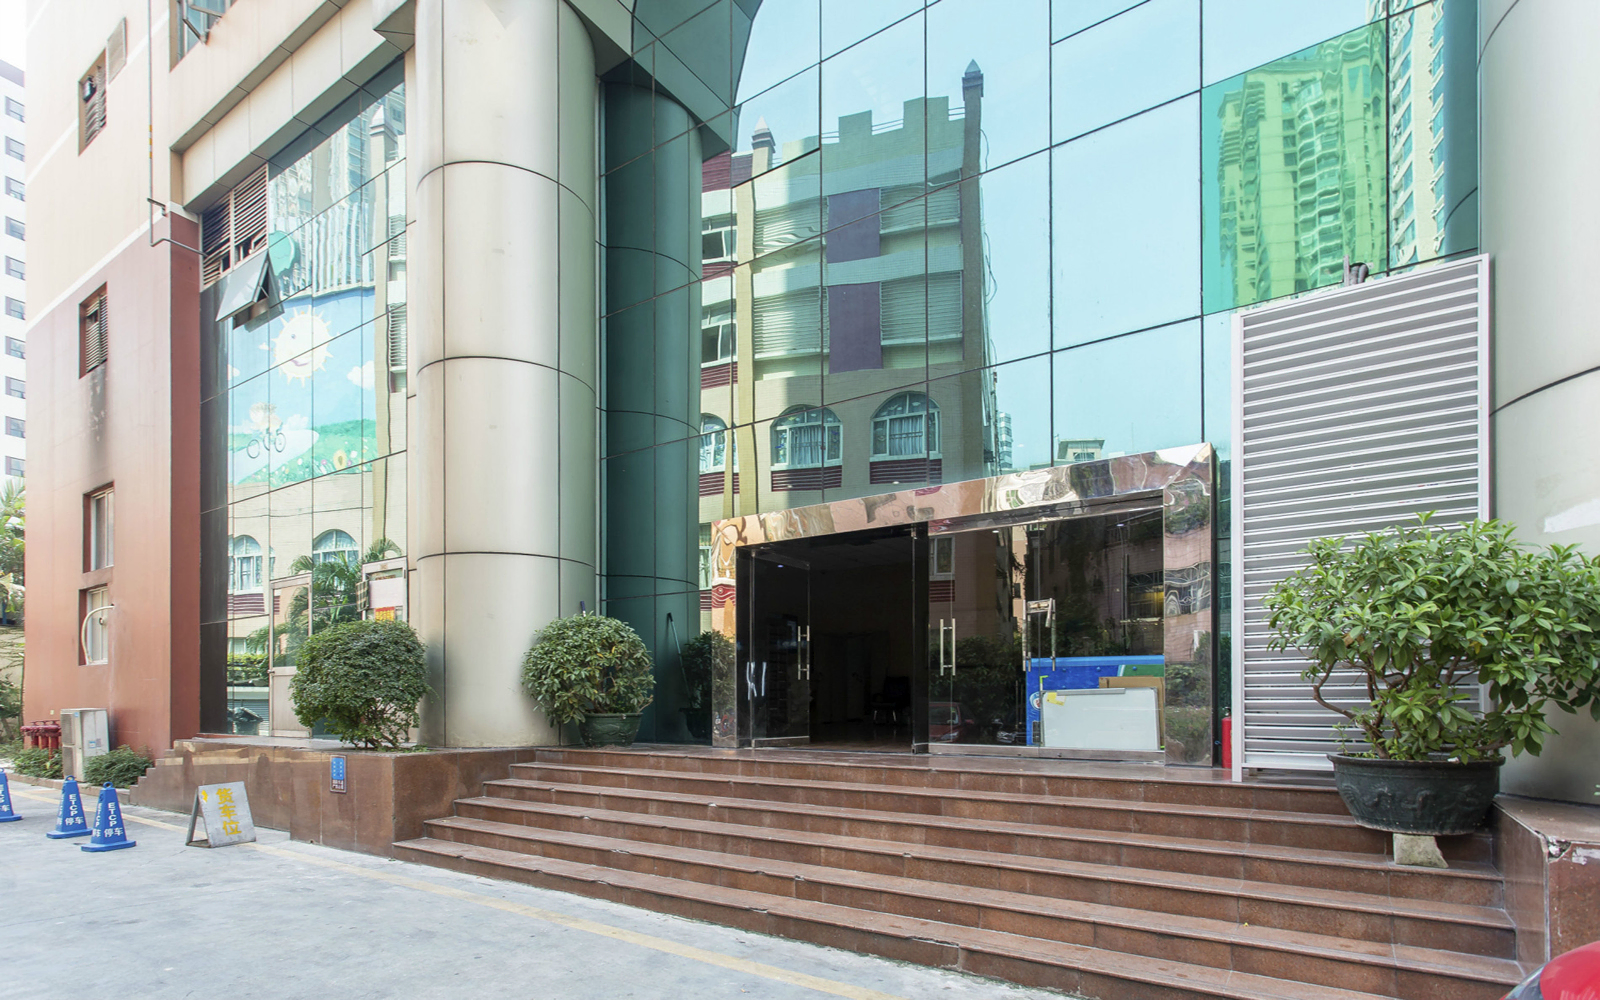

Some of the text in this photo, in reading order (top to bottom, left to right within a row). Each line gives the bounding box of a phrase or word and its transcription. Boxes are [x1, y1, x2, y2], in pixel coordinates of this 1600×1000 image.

[69, 794, 78, 816] ETCP
[65, 816, 84, 826] 停车
[108, 802, 117, 827] ETCP
[104, 827, 124, 838] 停车
